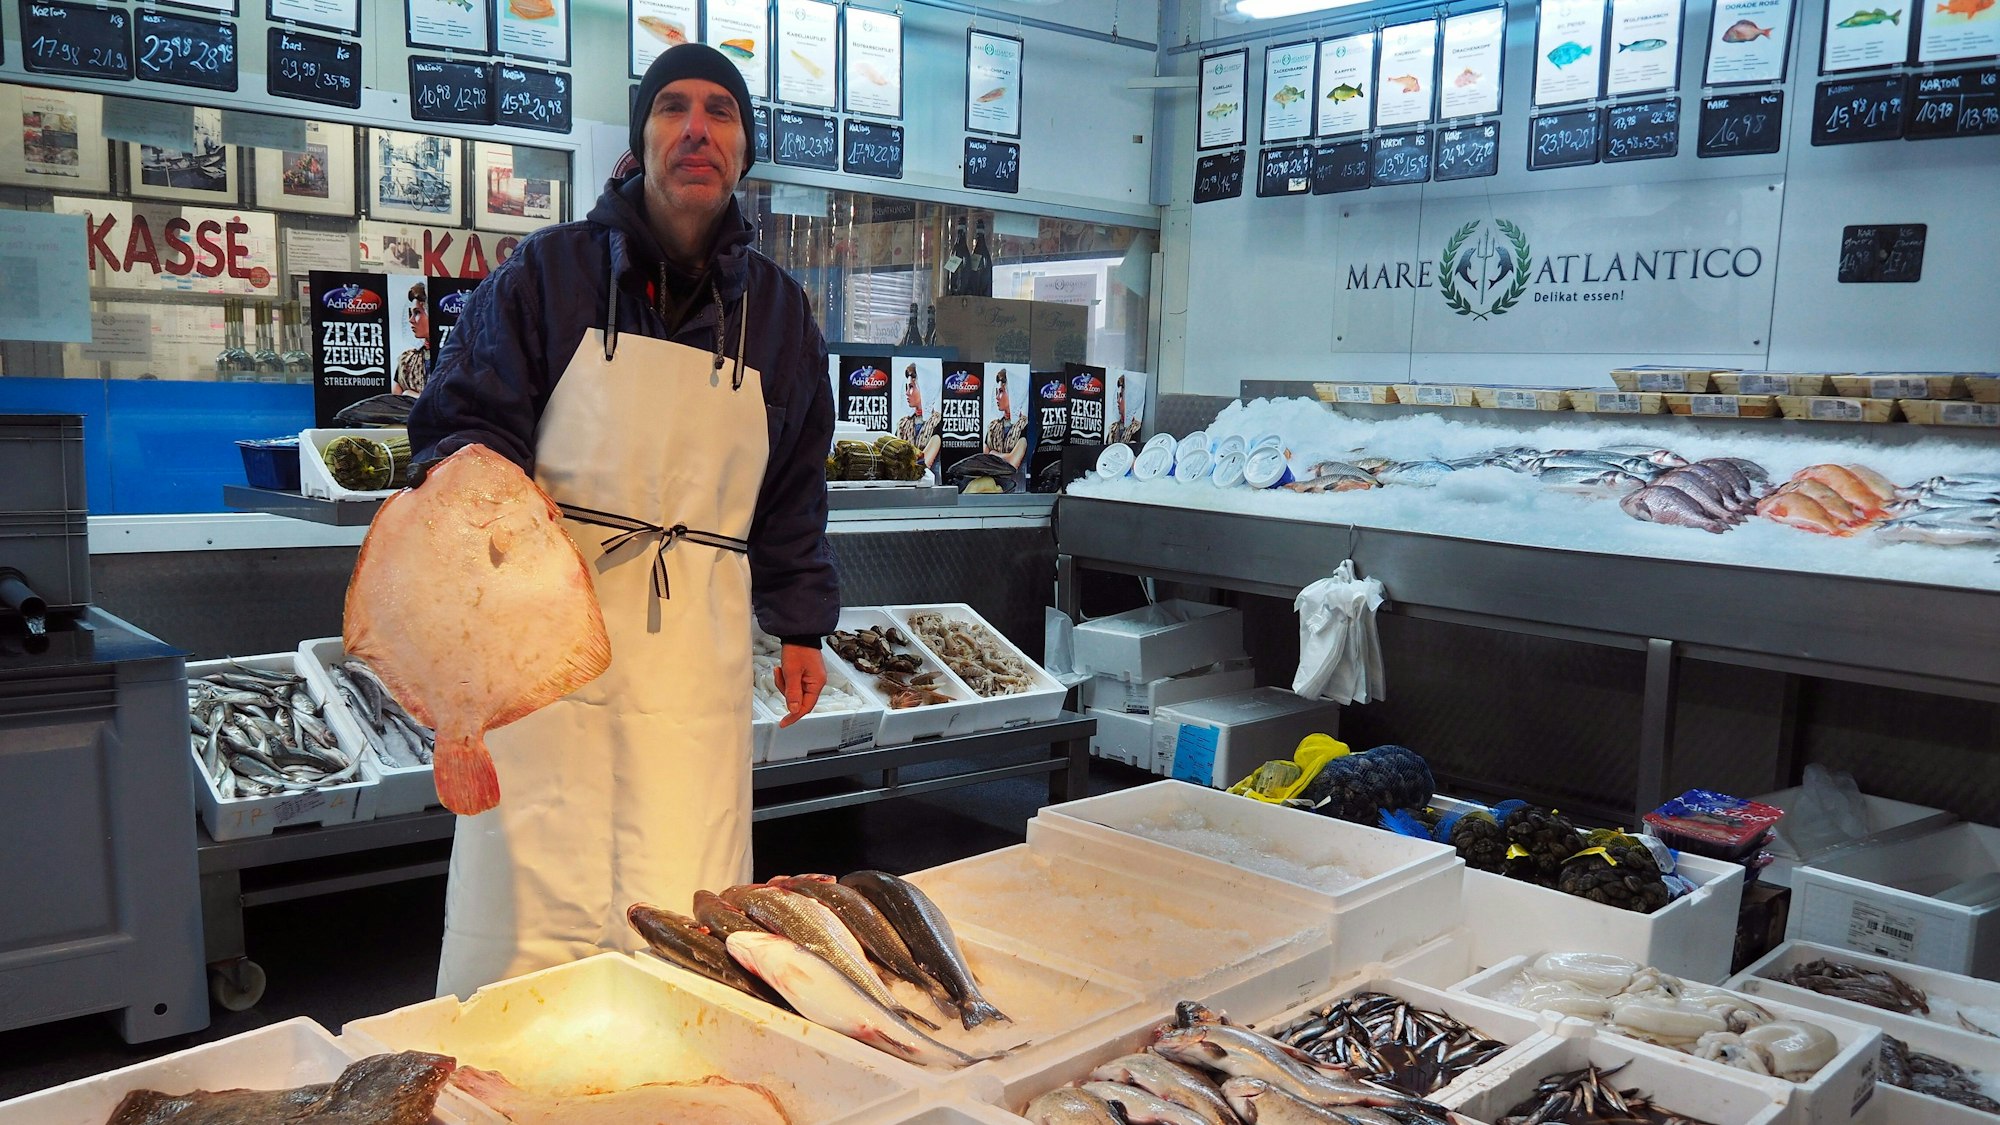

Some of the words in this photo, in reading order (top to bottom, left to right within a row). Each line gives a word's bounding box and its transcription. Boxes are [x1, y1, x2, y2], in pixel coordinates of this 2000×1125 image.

[1346, 260, 1433, 291] MARE
[1534, 245, 1762, 285] ATLANTICO
[1534, 291, 1578, 303] Delikat
[1583, 290, 1624, 301] essen!
[322, 321, 384, 347] ZEKER
[323, 346, 385, 366] ZEEUWS
[324, 377, 385, 387] STREEKPRODUCT
[848, 395, 888, 416] ZEKER
[943, 399, 980, 418] ZEKER
[1070, 398, 1102, 419] ZEKER
[942, 417, 980, 432] ZEEUWS
[1041, 407, 1067, 426] ZEKE
[1070, 415, 1103, 432] ZEEUWS
[942, 440, 980, 448] STREEKPRODUCT
